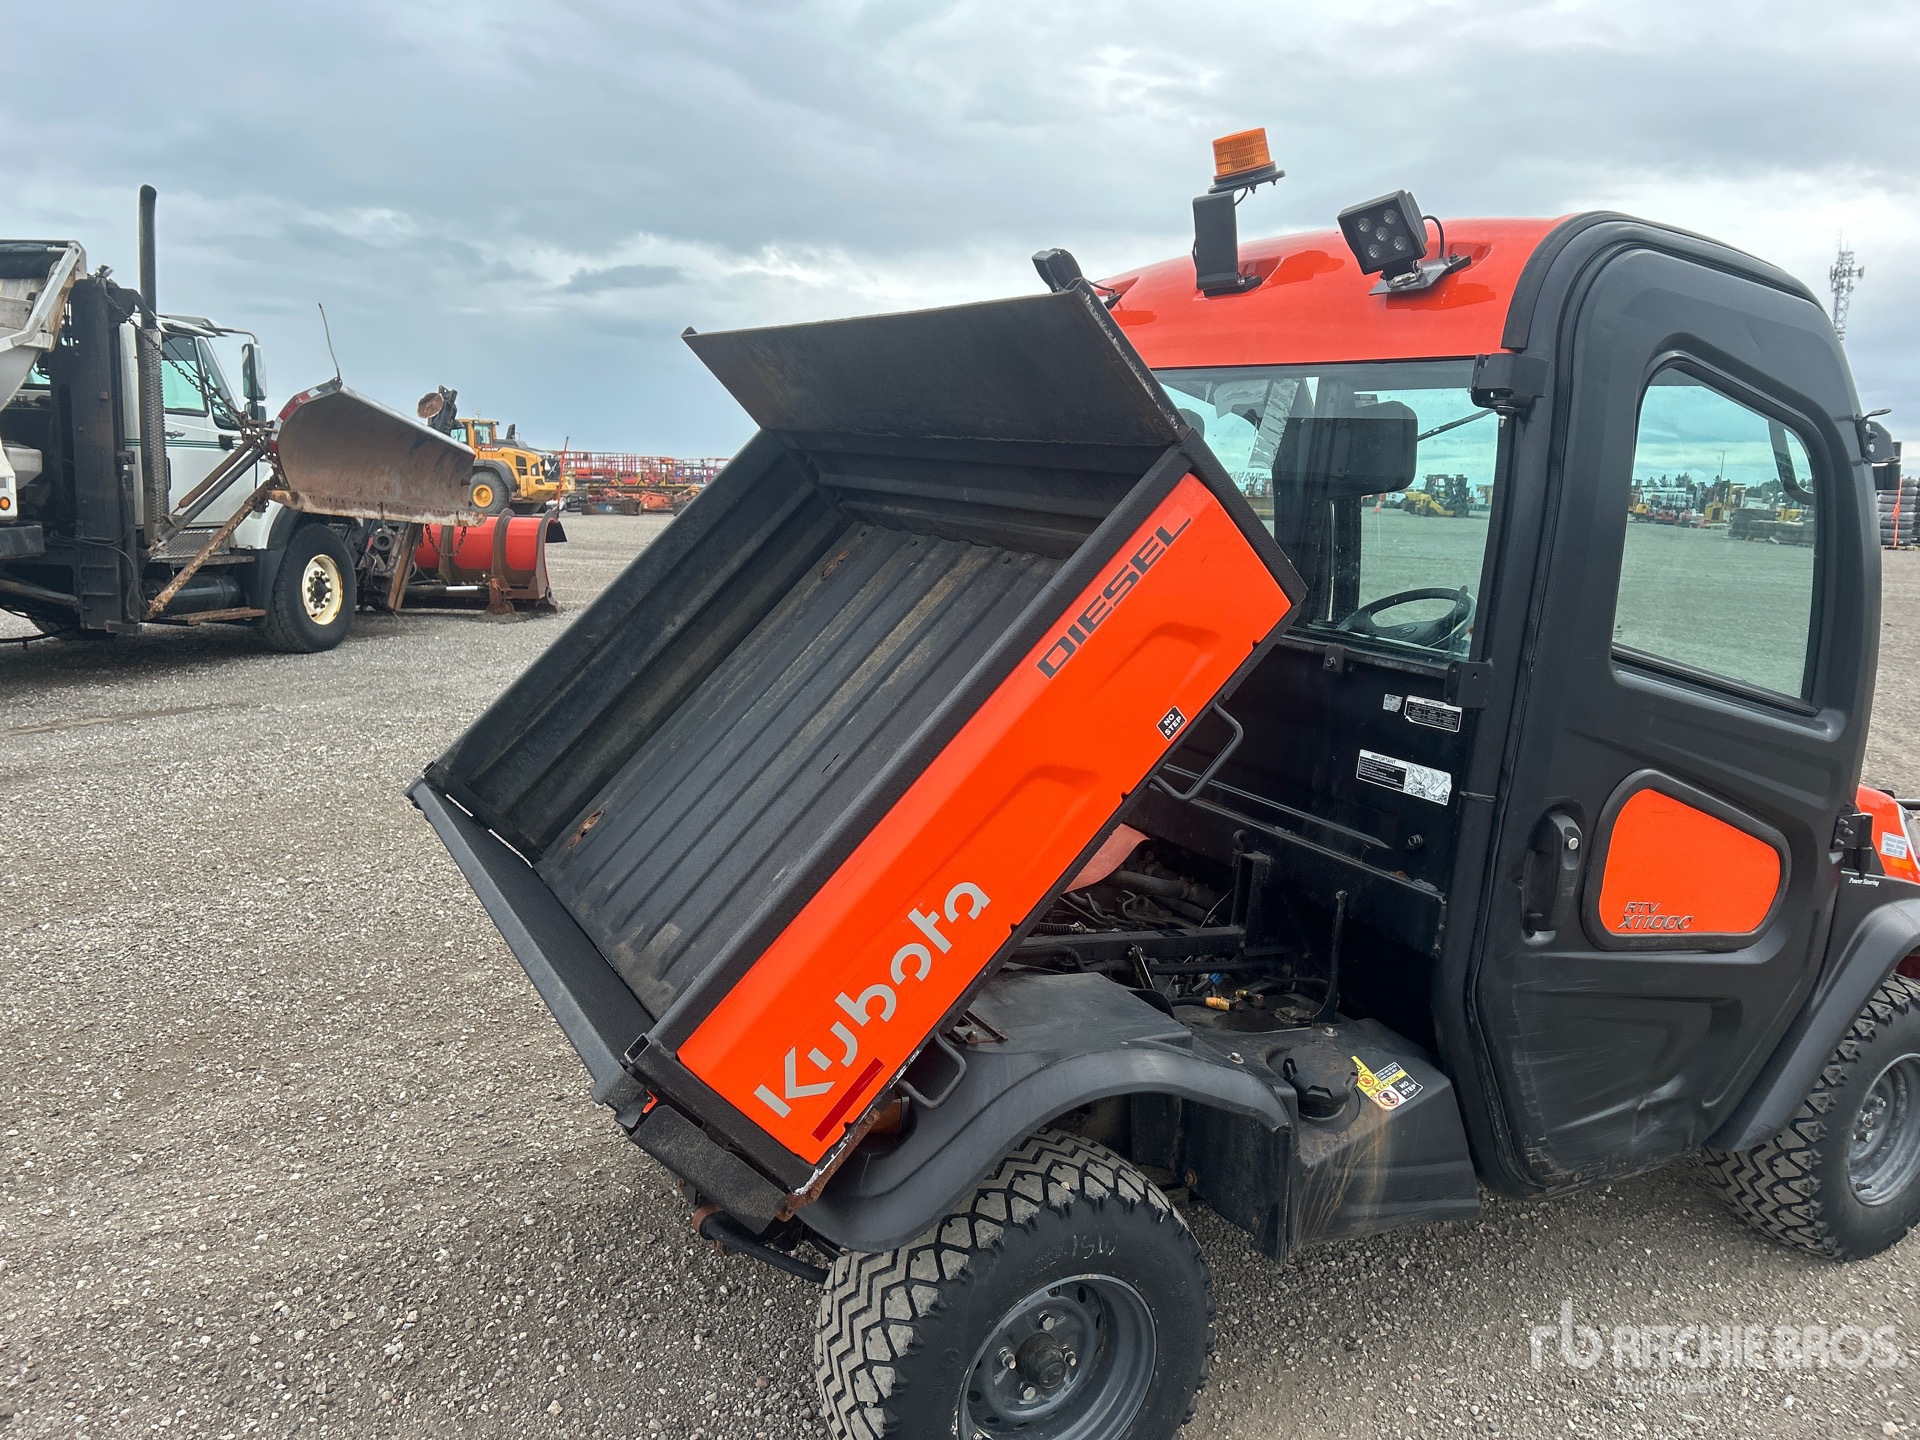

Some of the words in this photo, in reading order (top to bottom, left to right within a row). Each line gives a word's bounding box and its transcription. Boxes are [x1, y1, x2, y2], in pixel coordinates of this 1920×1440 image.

[1037, 518, 1191, 679] DIESEL
[1163, 713, 1175, 726] NO
[1164, 715, 1182, 736] STEP
[1371, 754, 1397, 765] IMPORTANT
[1624, 901, 1660, 913] RTV
[1617, 914, 1694, 930] X1100C
[754, 882, 991, 1119] Kubota
[1399, 1080, 1410, 1089] NO
[1400, 1083, 1417, 1096] STEP
